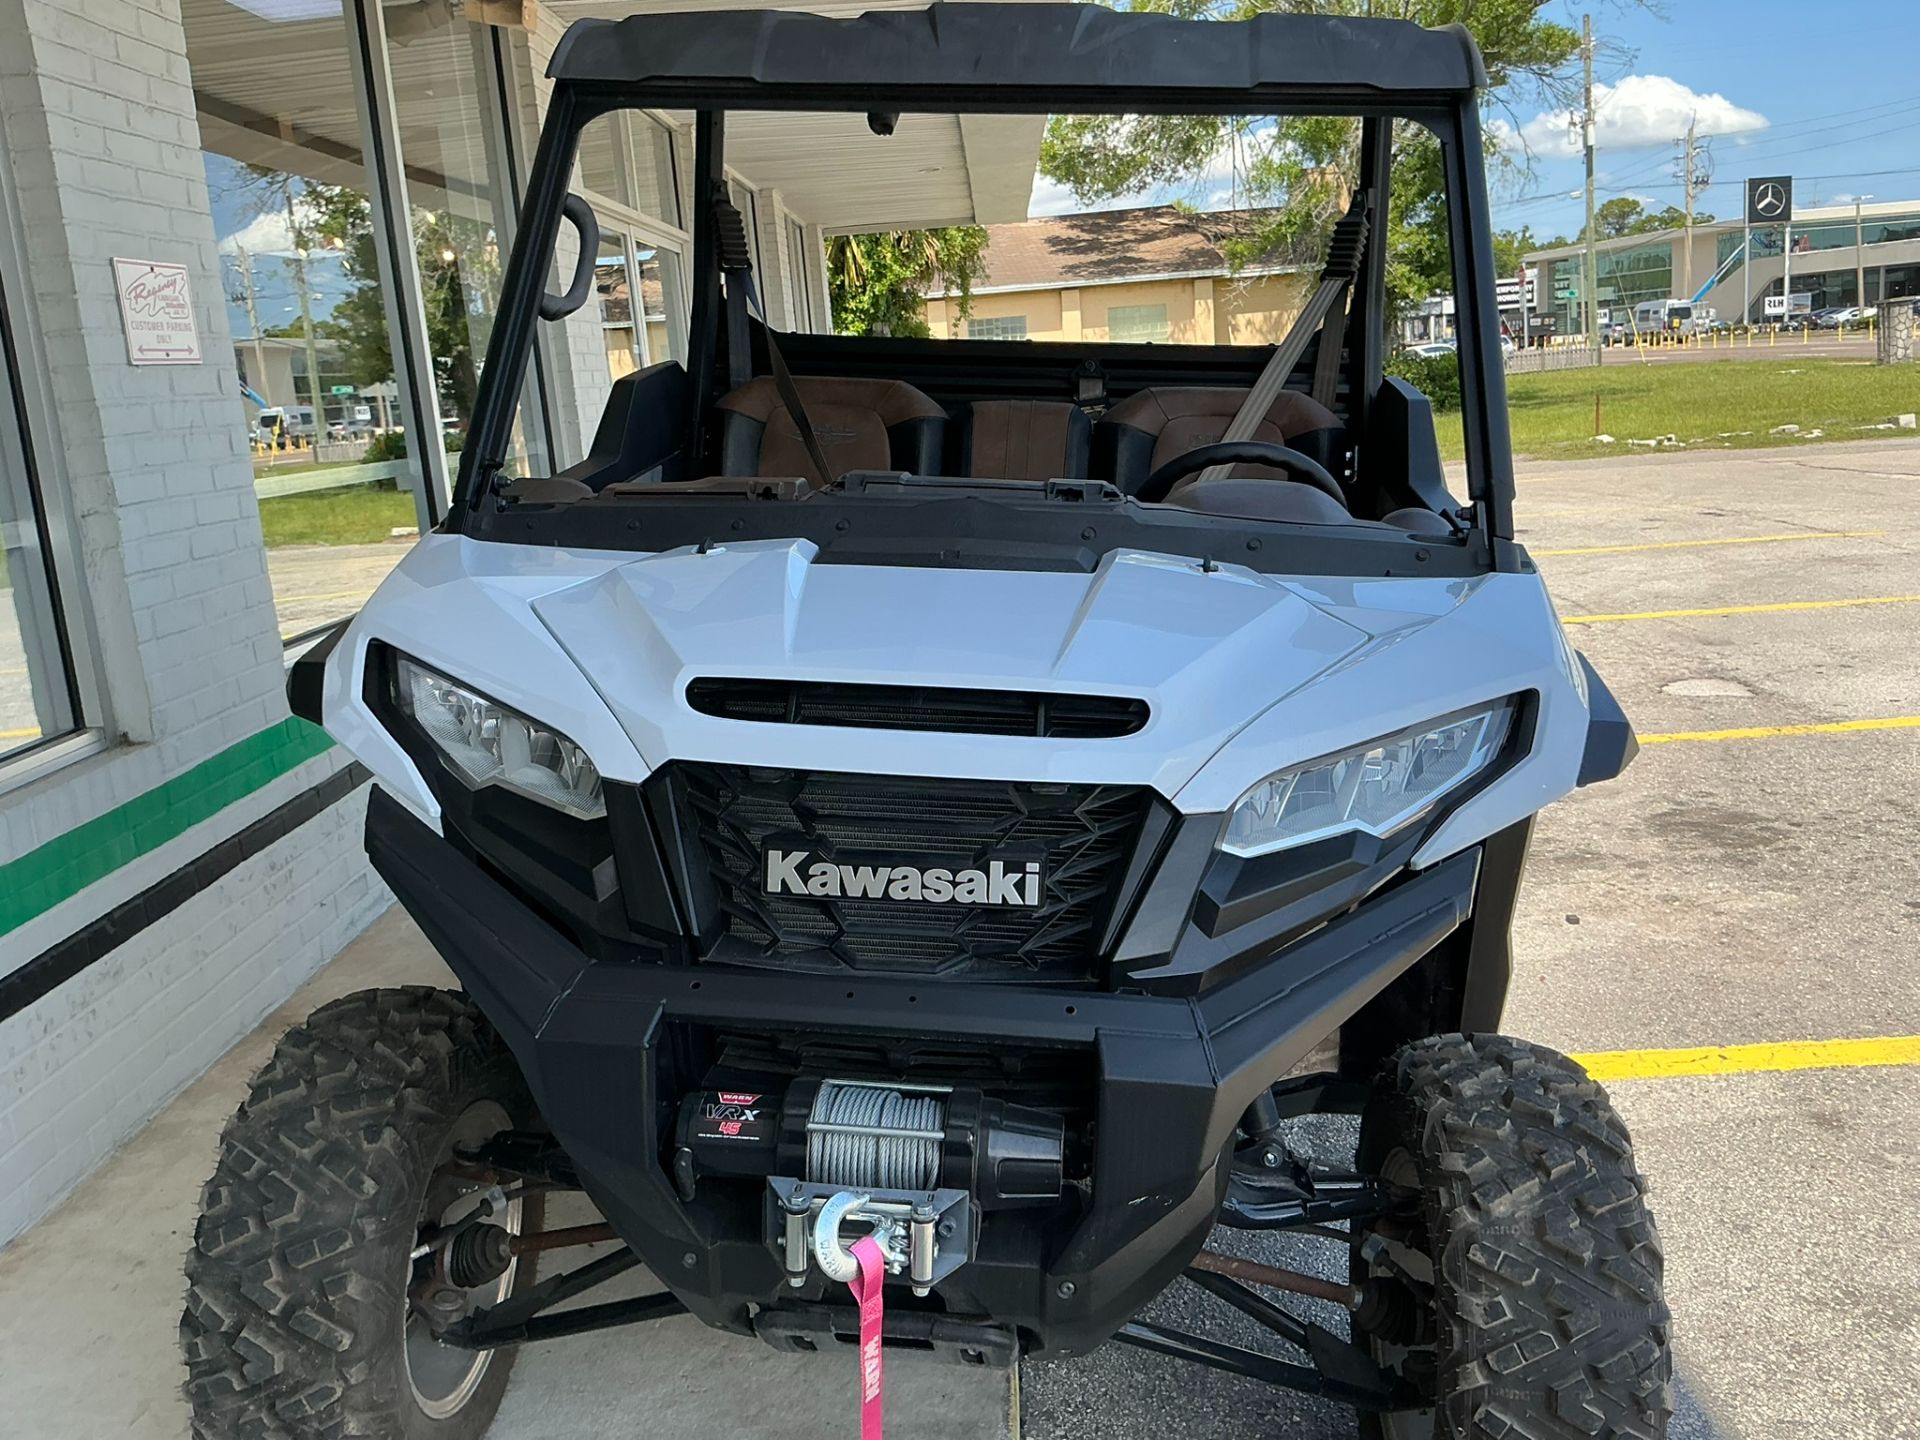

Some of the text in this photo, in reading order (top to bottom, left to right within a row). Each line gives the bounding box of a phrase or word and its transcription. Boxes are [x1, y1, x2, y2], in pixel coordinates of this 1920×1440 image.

[130, 320, 193, 332] CUSTOMER PARKING
[156, 334, 173, 344] ONLY
[767, 849, 1040, 906] Kawasaki
[719, 1121, 742, 1135] 45
[820, 1240, 842, 1276] WARN
[863, 1334, 880, 1404] WARN
